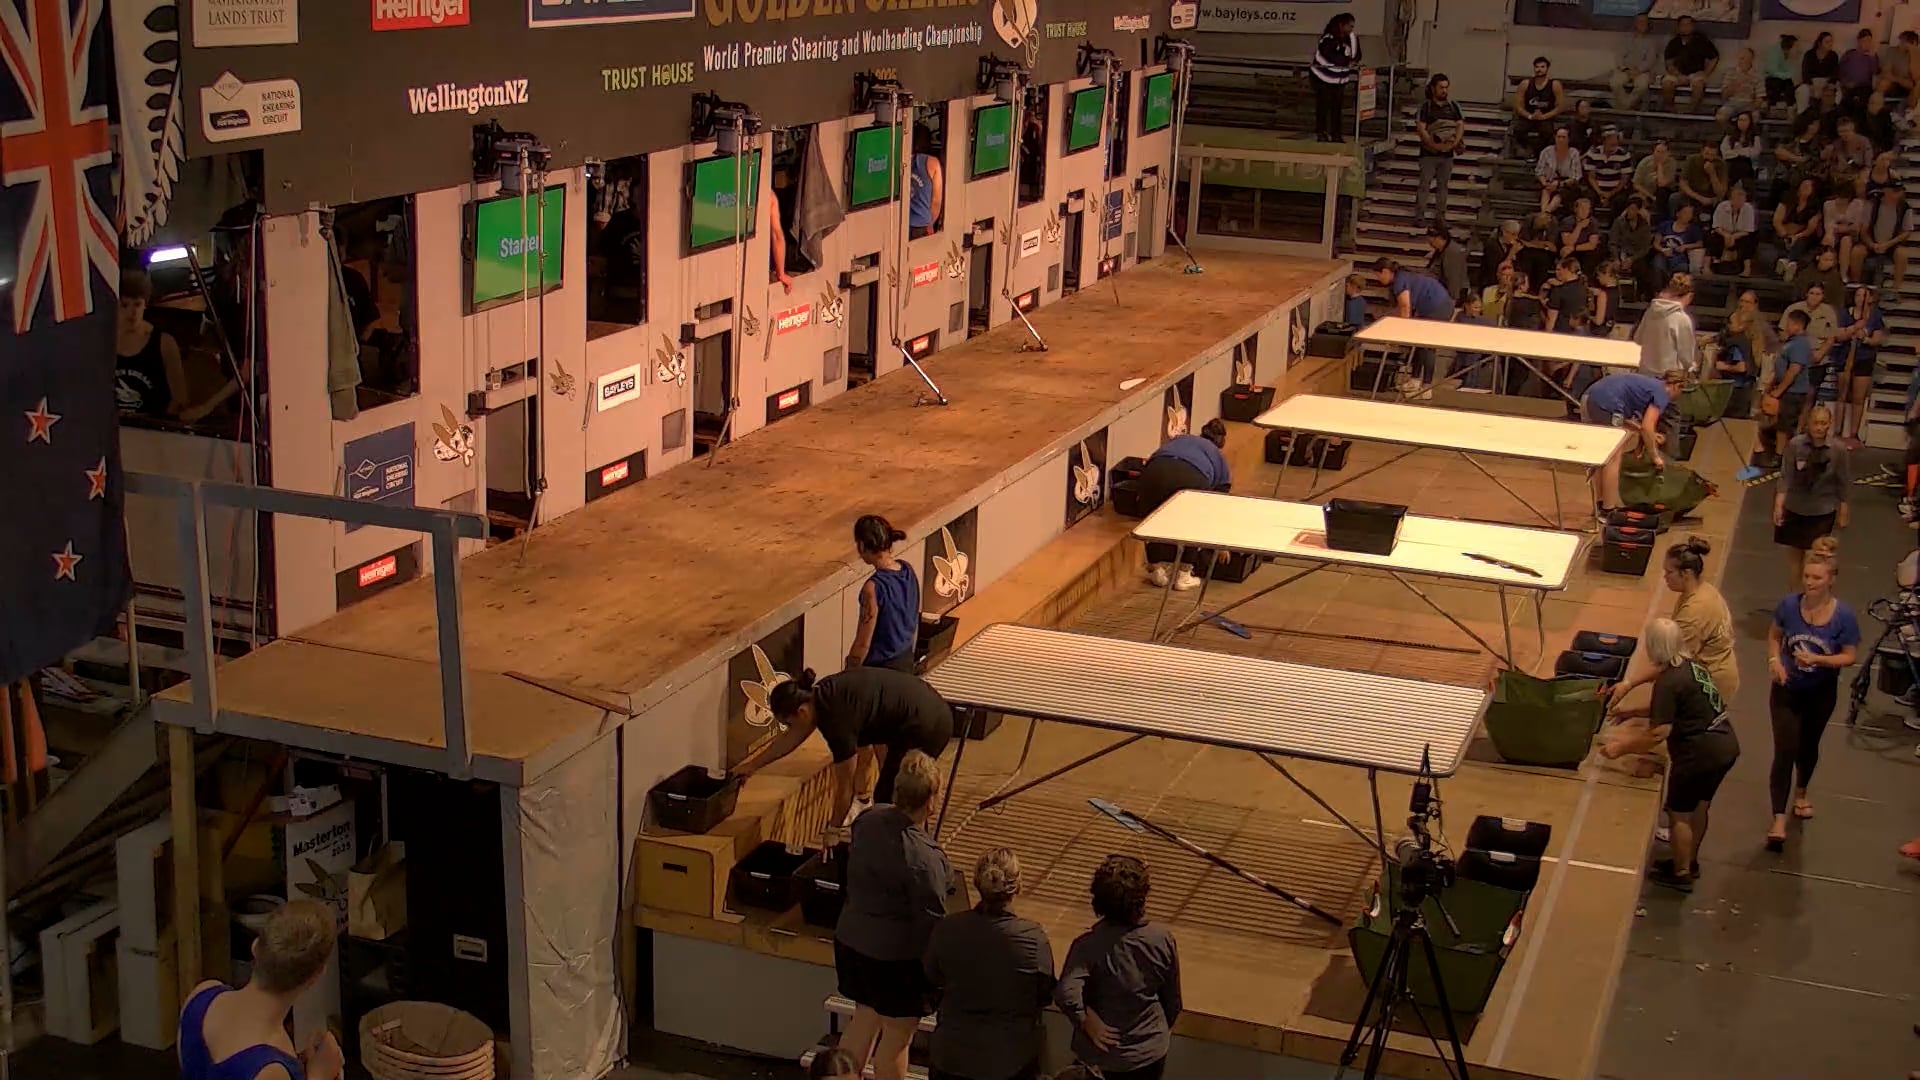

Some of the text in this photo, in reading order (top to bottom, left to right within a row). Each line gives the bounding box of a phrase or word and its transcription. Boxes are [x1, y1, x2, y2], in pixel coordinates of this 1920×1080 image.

[209, 9, 285, 26] LANDS TRUST
[704, 0, 854, 26] GOLD
[1046, 23, 1066, 39] TRUST
[704, 22, 982, 72] World Premier Shearing and Woolhandling Championship
[602, 62, 694, 91] TRUST HOUSE
[262, 89, 295, 101] NATIONAL
[408, 79, 529, 115] WellingtonNZ
[262, 113, 288, 125] CIRCUIT
[604, 379, 634, 398] BAYLEYS
[293, 822, 350, 857] Masterton
